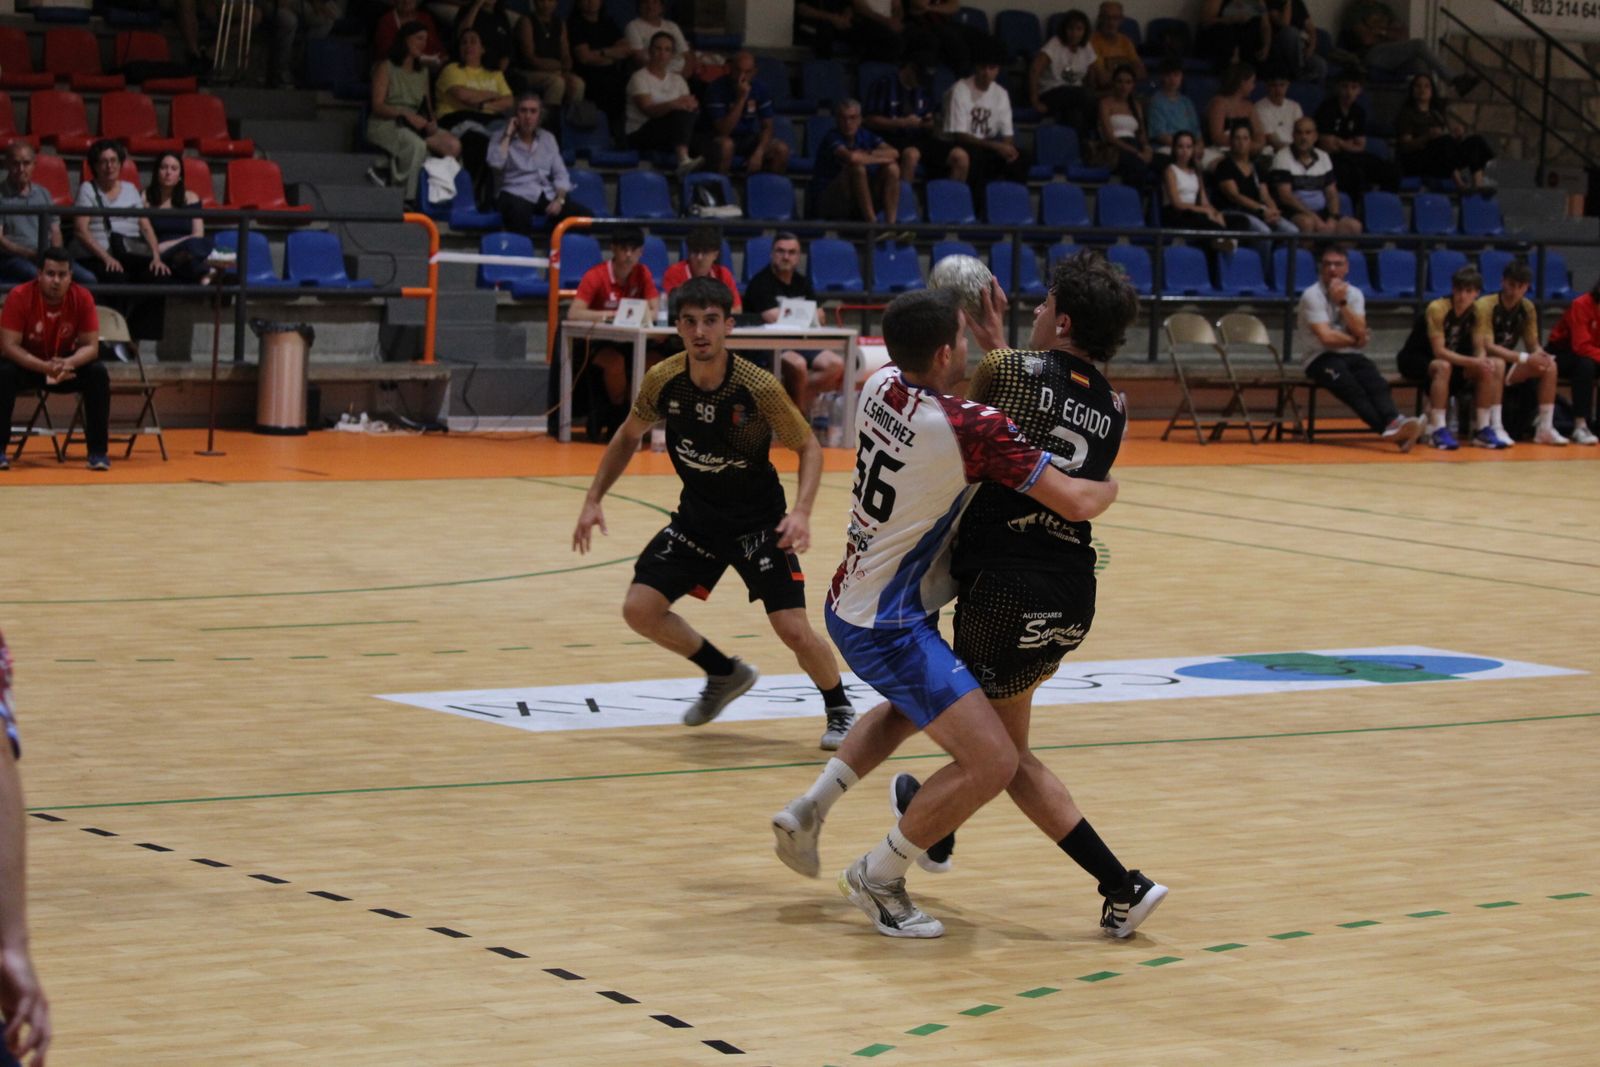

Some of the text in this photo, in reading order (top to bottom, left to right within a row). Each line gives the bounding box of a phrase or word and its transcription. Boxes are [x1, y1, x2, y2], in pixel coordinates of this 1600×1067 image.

[1532, 0, 1552, 15] 923
[1557, 1, 1578, 16] 214
[1582, 2, 1600, 18] 64
[695, 402, 715, 423] 98
[1062, 398, 1112, 440] EGIDO
[852, 430, 906, 523] 56
[1022, 611, 1063, 620] AUTOCARES
